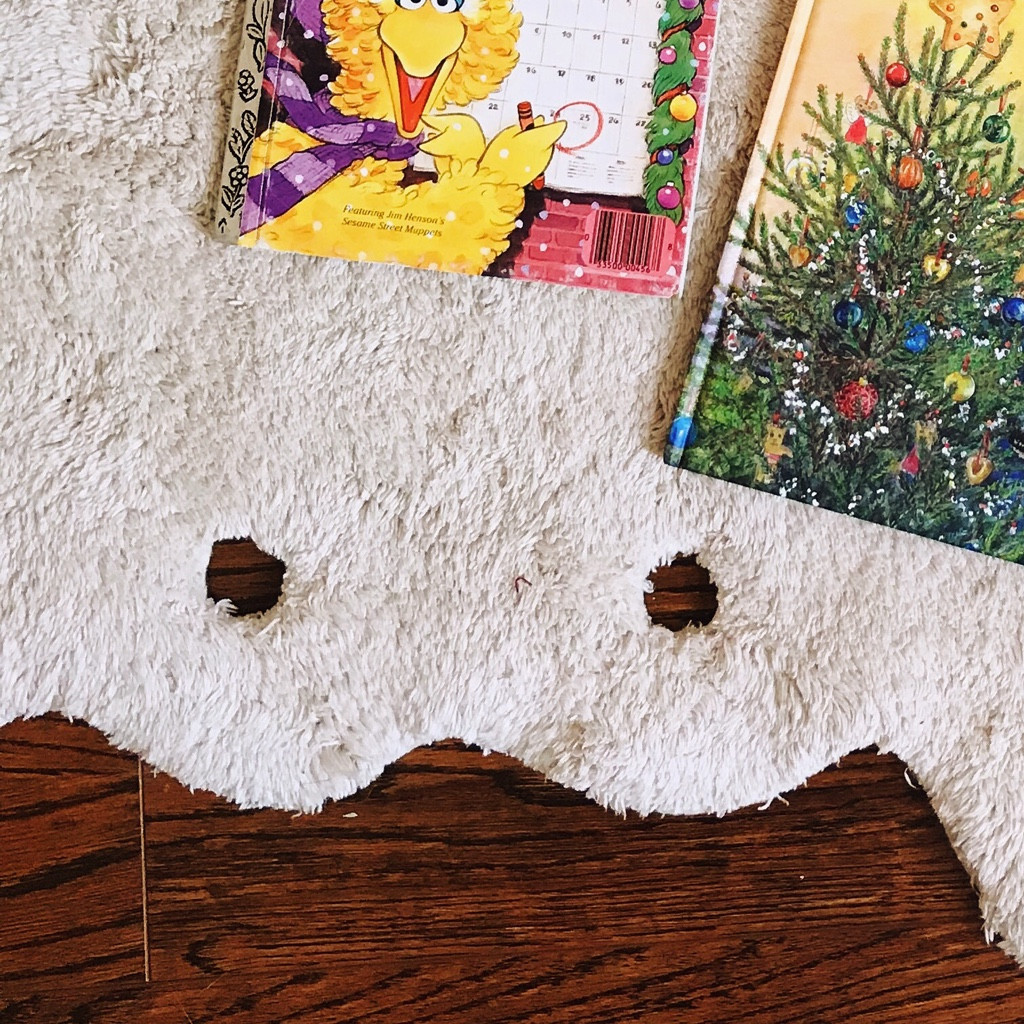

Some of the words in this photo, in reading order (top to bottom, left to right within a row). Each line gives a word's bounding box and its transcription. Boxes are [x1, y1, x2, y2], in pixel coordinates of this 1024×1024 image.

[580, 114, 591, 122] 25
[343, 205, 385, 219] Featuring
[386, 211, 403, 220] Jim
[404, 213, 446, 226] Henson's
[342, 217, 376, 229] Sesame
[377, 222, 403, 233] Street
[405, 224, 443, 237] Muppets
